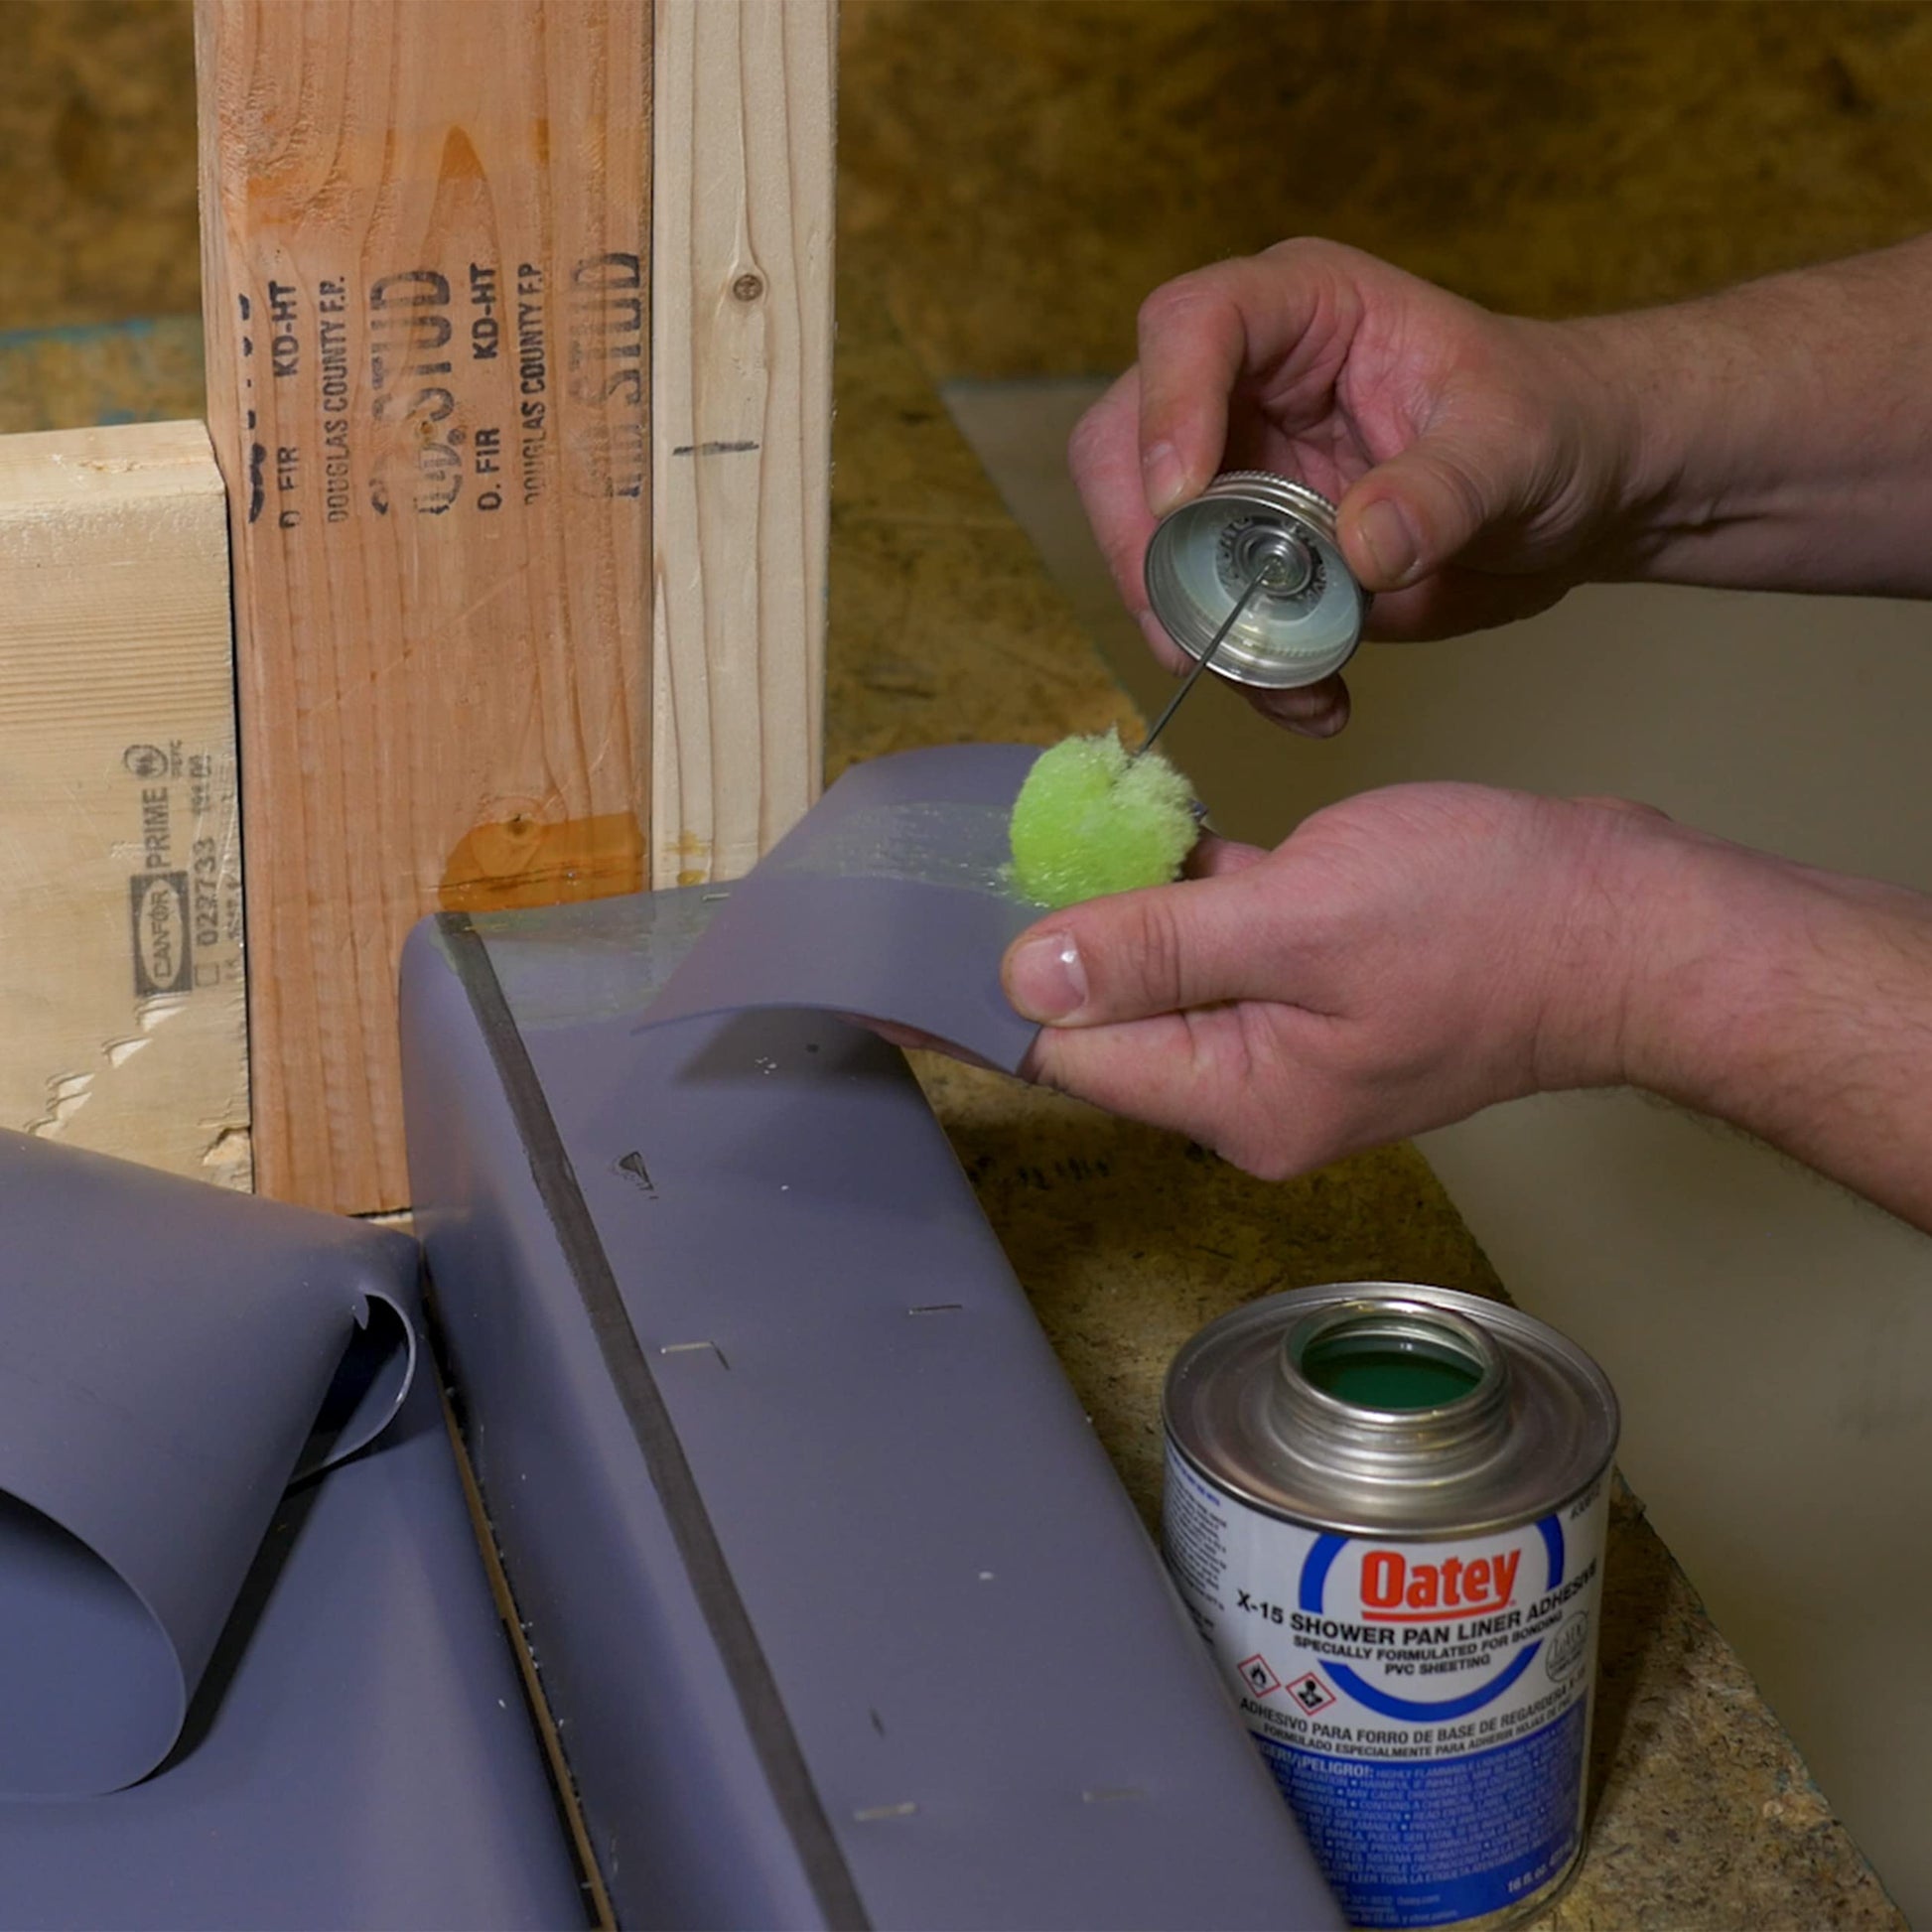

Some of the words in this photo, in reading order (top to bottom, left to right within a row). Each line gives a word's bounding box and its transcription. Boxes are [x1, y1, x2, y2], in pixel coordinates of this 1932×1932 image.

[269, 280, 300, 377] KD-HT
[470, 262, 498, 359] KD-HT
[320, 319, 348, 413] COUNTY
[517, 303, 545, 395] COUNTY
[476, 428, 500, 474] FIR
[143, 787, 171, 872] PRIME
[151, 889, 173, 981] CANFOR
[1360, 1548, 1521, 1611] Oatey
[1237, 1587, 1284, 1625] X-15
[1290, 1612, 1395, 1645] SHOWER
[1402, 1625, 1449, 1646] PAN
[1457, 1609, 1521, 1642] LINER
[1293, 1635, 1372, 1661] SPECIALLY
[1376, 1642, 1477, 1662] FORMULATED
[1481, 1633, 1509, 1653] FOR
[1511, 1609, 1564, 1644] BONDING
[1385, 1661, 1415, 1676] PVC
[1419, 1653, 1490, 1675] SHEETING
[1241, 1697, 1308, 1732] ADHESIVO
[1311, 1722, 1351, 1741] PARA
[1356, 1728, 1408, 1744] FORRO
[1413, 1729, 1433, 1743] DE
[1437, 1725, 1475, 1742] BASE
[1479, 1719, 1499, 1732] DE
[1264, 1723, 1331, 1753] FORMULADO
[1335, 1743, 1432, 1758] ESPECIALMENTE
[1435, 1743, 1465, 1756] PARA
